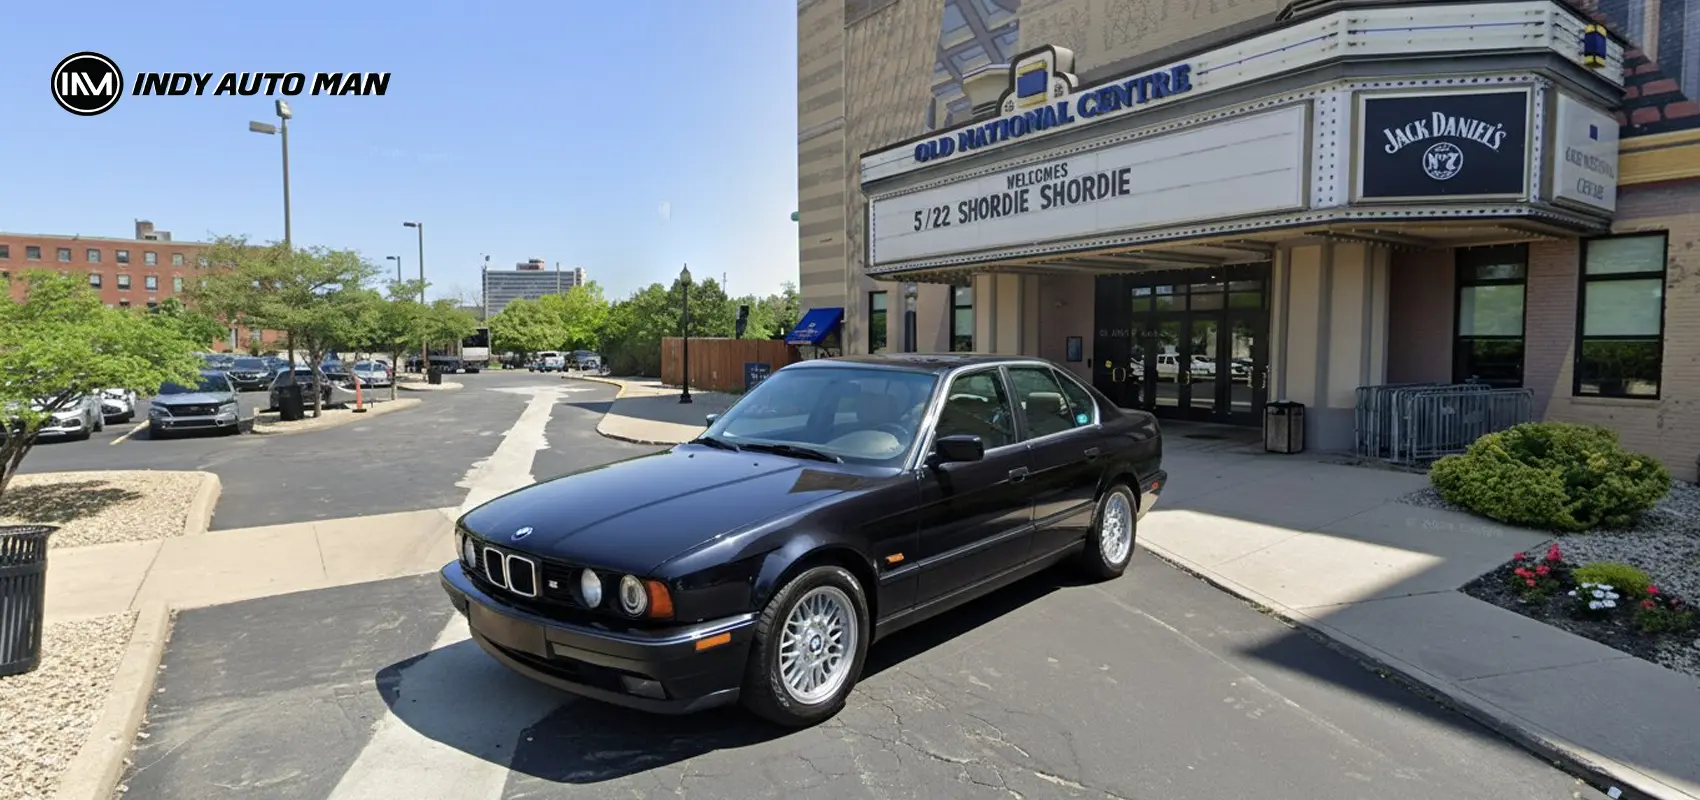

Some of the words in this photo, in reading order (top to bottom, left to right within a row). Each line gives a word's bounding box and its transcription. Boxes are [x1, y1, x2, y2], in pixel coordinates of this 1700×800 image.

[914, 136, 955, 162] OLD
[958, 101, 1075, 152] NATIONAL
[1077, 63, 1193, 119] CENTRE
[1383, 118, 1430, 154] JACK
[1432, 111, 1507, 152] DANIEL'S
[914, 204, 951, 231] 5/22
[958, 188, 1029, 224] SHORDIE
[1040, 167, 1131, 210] SHORDIE
[1007, 162, 1068, 190] WELCOMES
